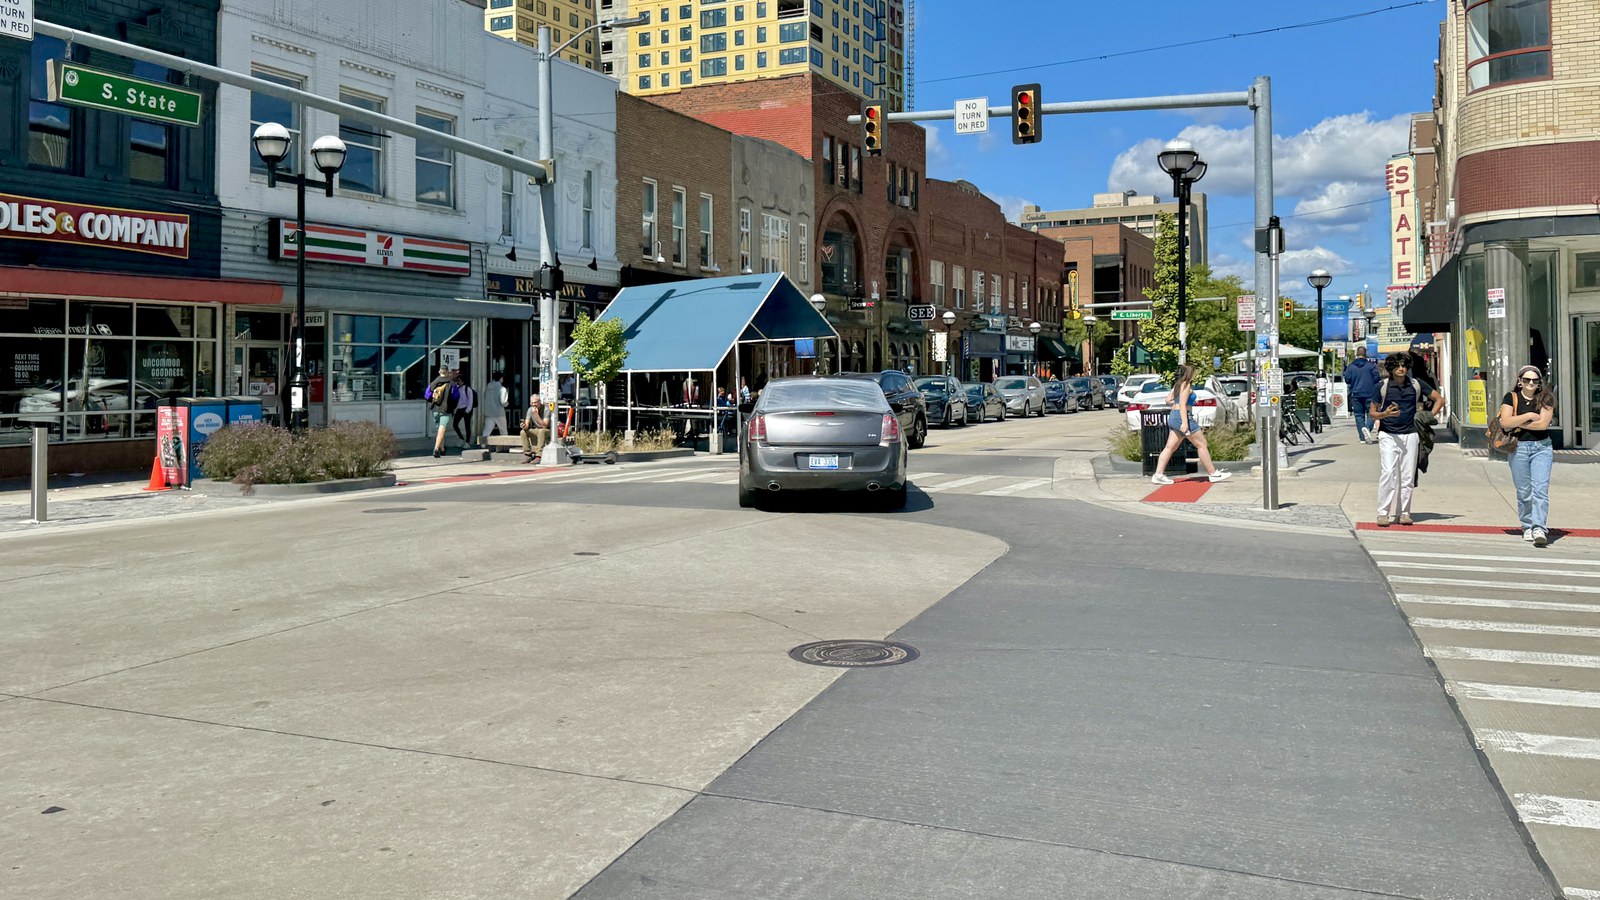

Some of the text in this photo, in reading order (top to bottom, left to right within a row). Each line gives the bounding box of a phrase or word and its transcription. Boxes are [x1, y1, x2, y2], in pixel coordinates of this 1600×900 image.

[0, 5, 24, 19] TURN
[11, 21, 29, 32] RED
[101, 82, 176, 112] S. State
[965, 102, 977, 110] NO
[962, 112, 981, 120] TURN
[958, 120, 985, 130] ON RED
[1395, 165, 1412, 280] STATE
[61, 214, 77, 234] &
[79, 211, 189, 249] COMPANY
[515, 277, 541, 294] RE
[561, 283, 587, 299] AWK
[911, 308, 934, 318] SEE
[142, 358, 181, 368] UNCOMMON
[151, 367, 184, 377] GOODNESS
